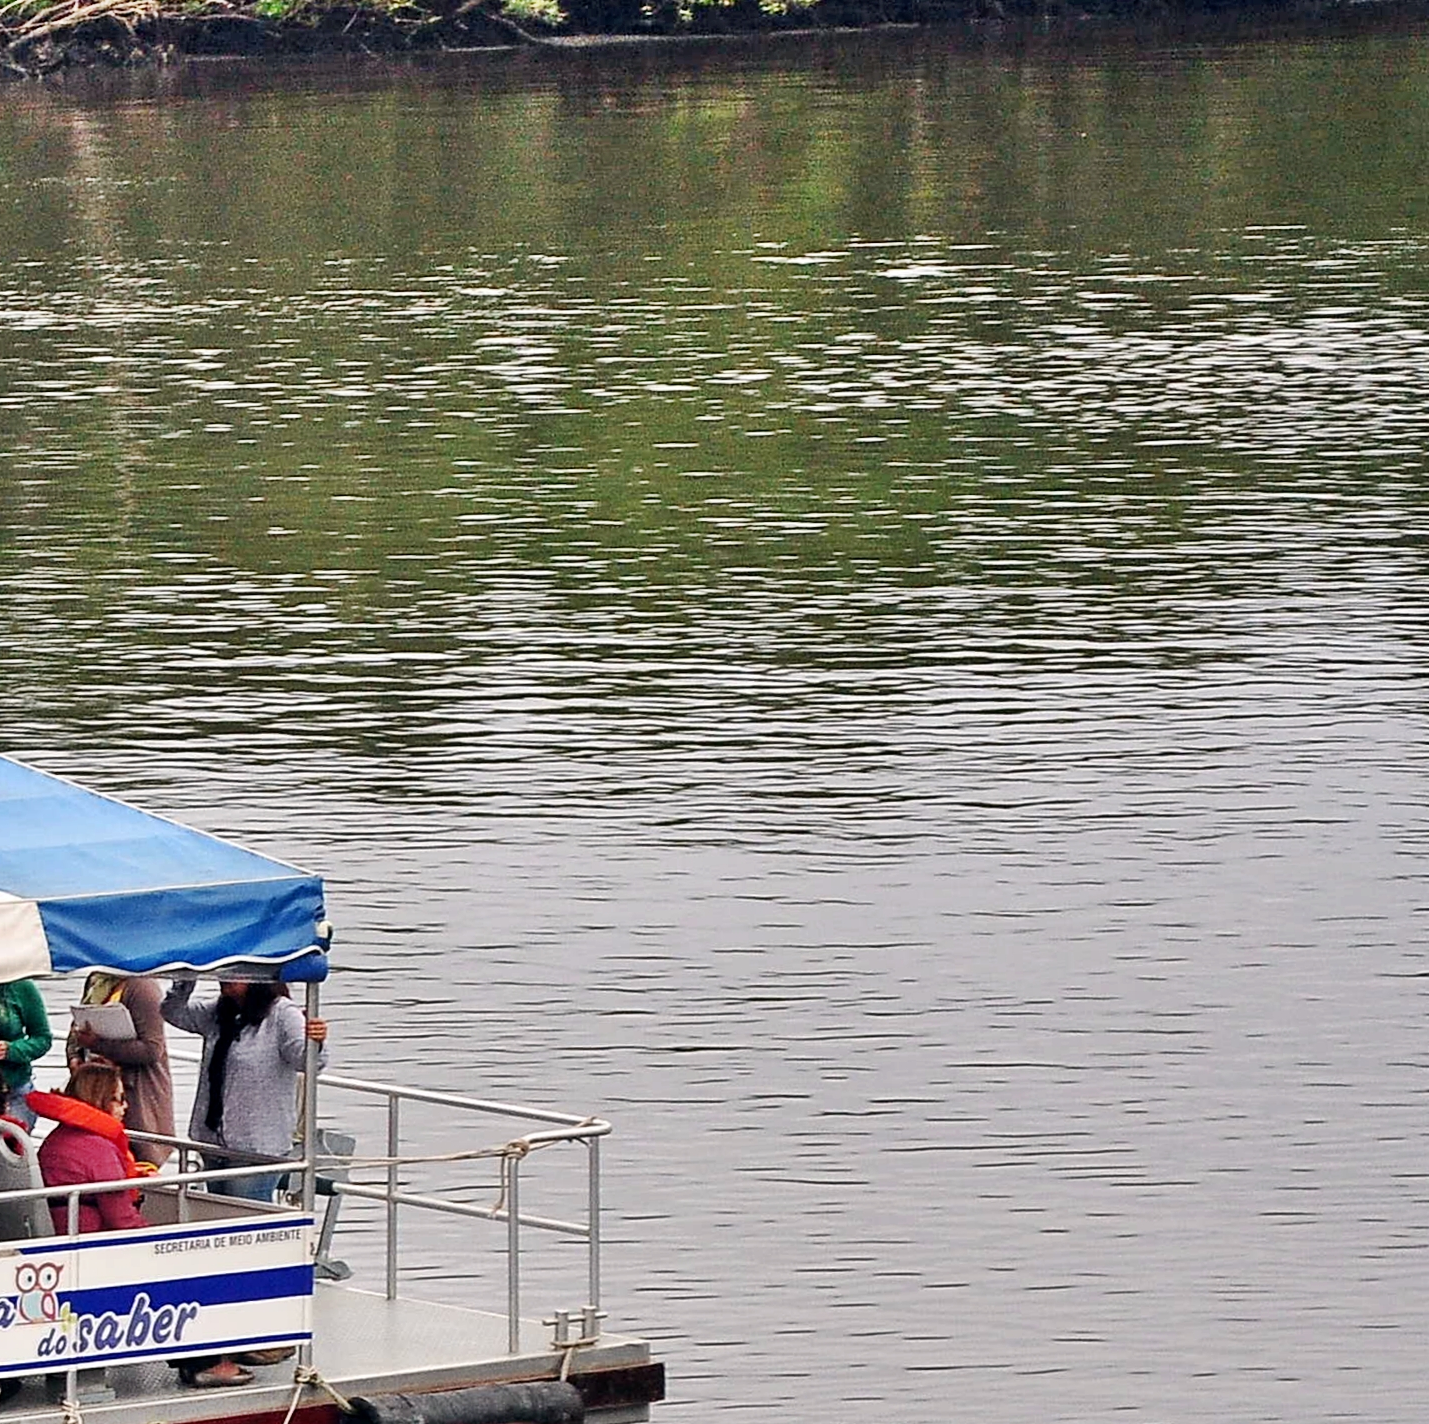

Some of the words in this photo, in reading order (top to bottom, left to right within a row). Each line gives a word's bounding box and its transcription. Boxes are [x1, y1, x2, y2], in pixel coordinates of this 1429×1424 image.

[153, 1236, 211, 1255] SECRETARIA
[214, 1235, 225, 1248] DE
[229, 1233, 252, 1246] MEIO
[255, 1228, 301, 1244] AMBIENTE
[37, 1327, 67, 1357] do
[72, 1294, 198, 1353] saber
